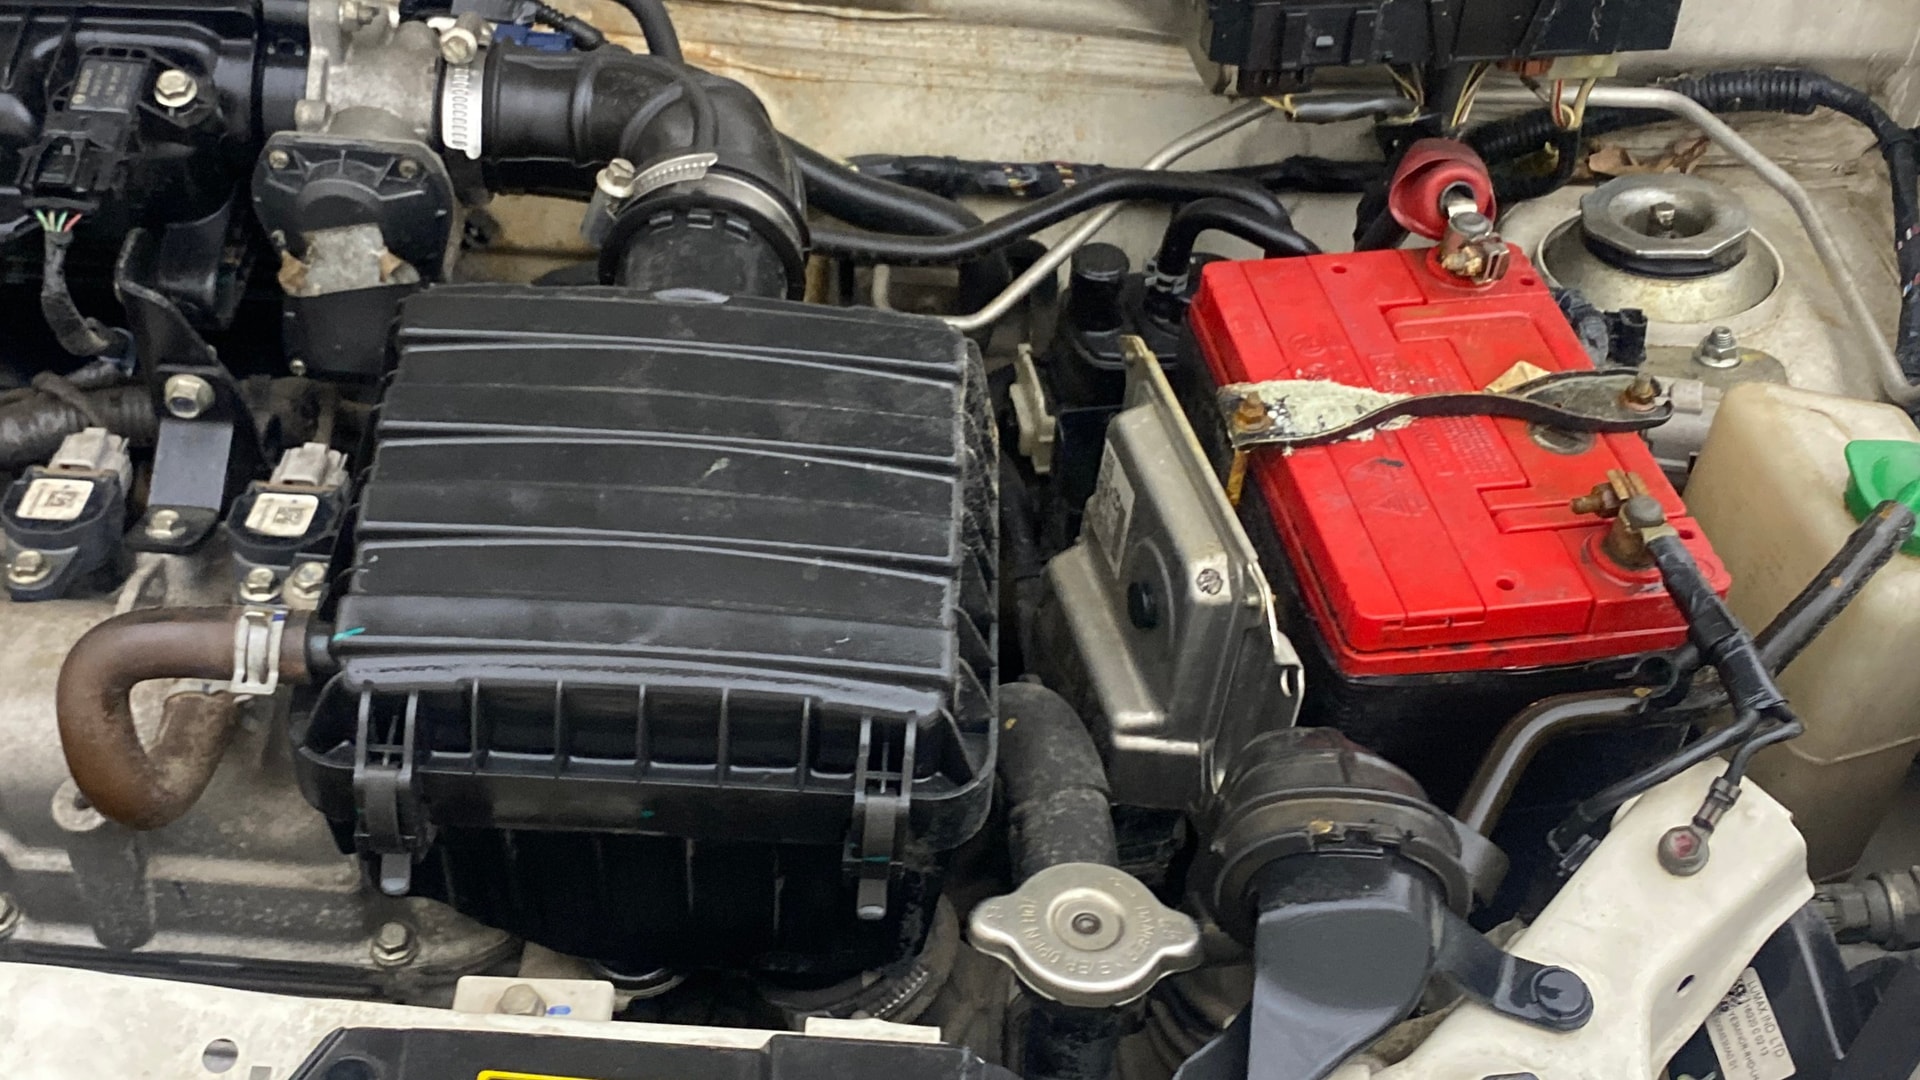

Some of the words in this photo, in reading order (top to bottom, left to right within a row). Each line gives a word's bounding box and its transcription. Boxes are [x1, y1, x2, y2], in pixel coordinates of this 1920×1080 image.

[1747, 979, 1768, 1014] LUMAX
[1761, 1014, 1775, 1034] IND
[1769, 1036, 1786, 1058] LTD
